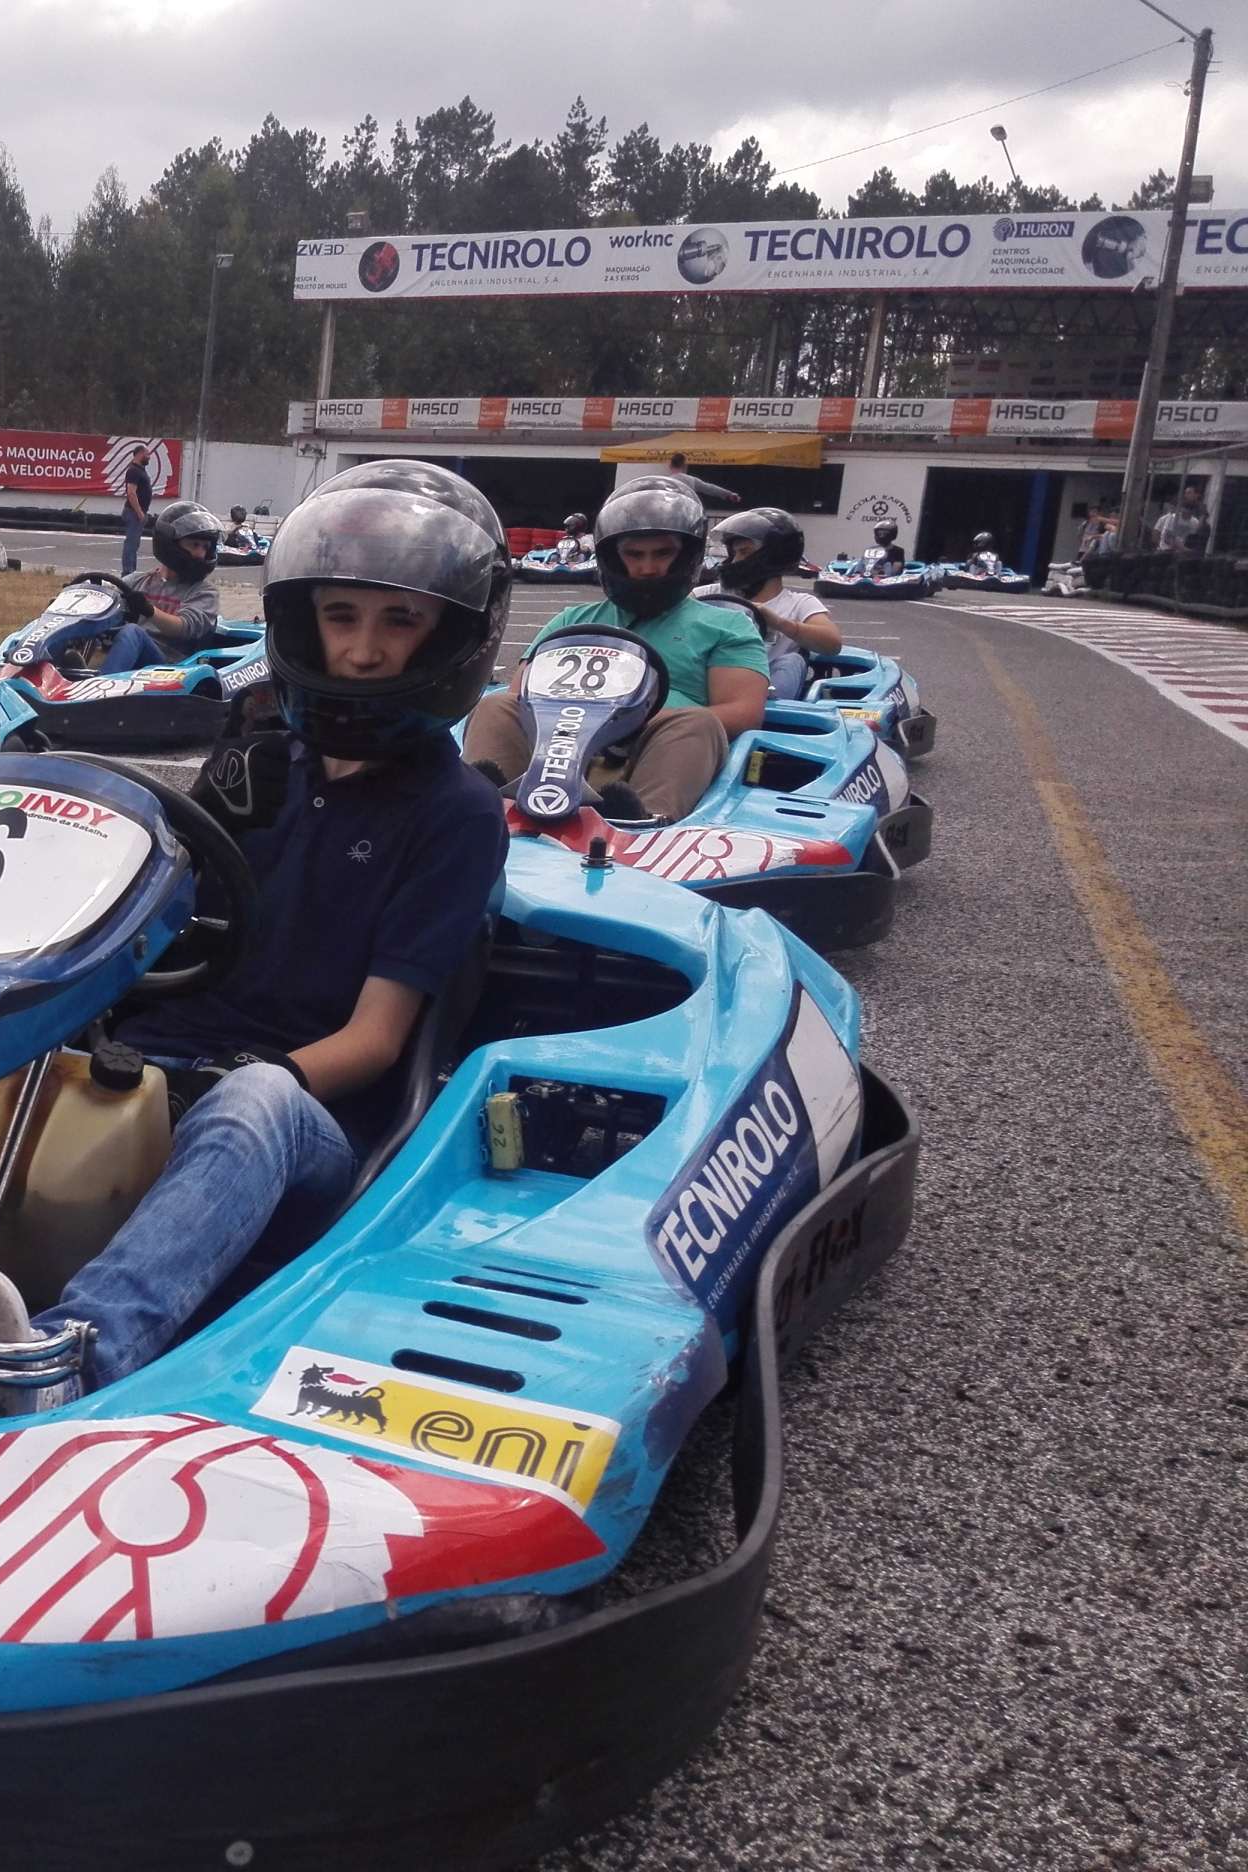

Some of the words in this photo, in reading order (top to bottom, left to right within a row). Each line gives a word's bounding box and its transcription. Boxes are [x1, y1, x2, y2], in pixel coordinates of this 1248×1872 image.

[1020, 223, 1070, 236] HURON
[609, 230, 674, 249] worknc
[744, 223, 971, 262] TECNIROLO
[411, 236, 592, 272] TECNIROLO
[992, 248, 1031, 256] CENTROS
[990, 256, 1049, 266] MAQUINAÇÃO
[767, 270, 834, 278] ENGENHARIA
[990, 267, 1010, 275] ALTA
[1012, 266, 1065, 275] VELOCIDADE
[430, 279, 483, 289] ENGENHARIA
[319, 403, 363, 416] HASCO
[411, 402, 459, 416] HASCO
[510, 402, 562, 415] HASCO
[617, 402, 673, 416] HASCO
[733, 403, 794, 417] HASCO
[859, 403, 924, 418] HASCO
[995, 404, 1065, 420] HASCO
[1157, 406, 1218, 422] ASCO
[6, 445, 95, 465] MAQUINAÇÃO
[9, 464, 92, 480] VELOCIDADE
[66, 594, 88, 611] 7
[546, 647, 621, 658] EUROIND
[548, 655, 610, 691] 28
[835, 764, 882, 803] NIROLO
[72, 822, 109, 839] Batalha
[656, 1079, 798, 1282] TECNIROLO
[707, 1240, 751, 1309] ENGENHARIA
[410, 1410, 592, 1492] eni
